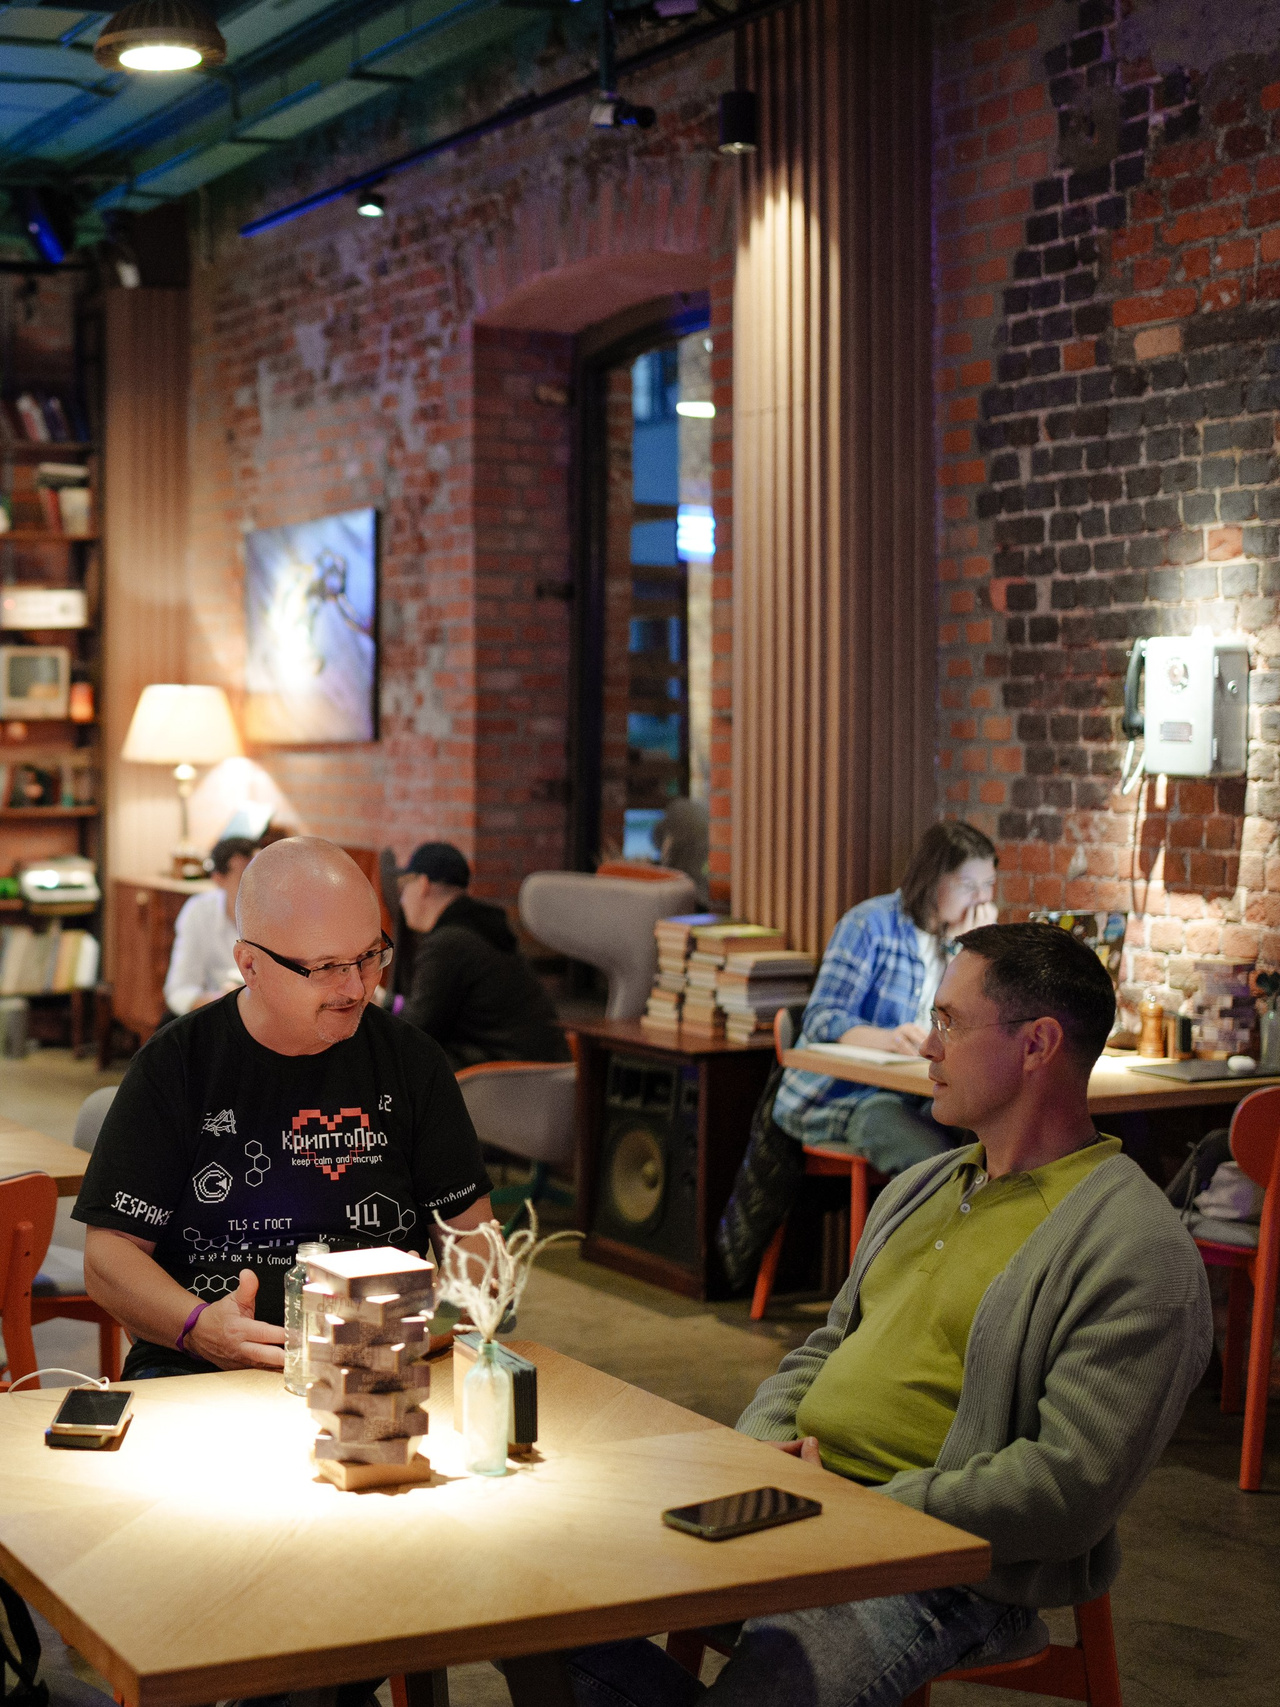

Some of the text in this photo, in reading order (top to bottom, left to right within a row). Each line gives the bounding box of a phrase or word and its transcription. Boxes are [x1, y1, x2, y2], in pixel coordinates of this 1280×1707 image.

[282, 1128, 388, 1154] КриптоПро
[292, 1154, 383, 1167] keep calm and encrypt
[228, 1219, 248, 1231] TLS
[265, 1218, 293, 1230] ГОСТ
[346, 1204, 380, 1229] УЦ
